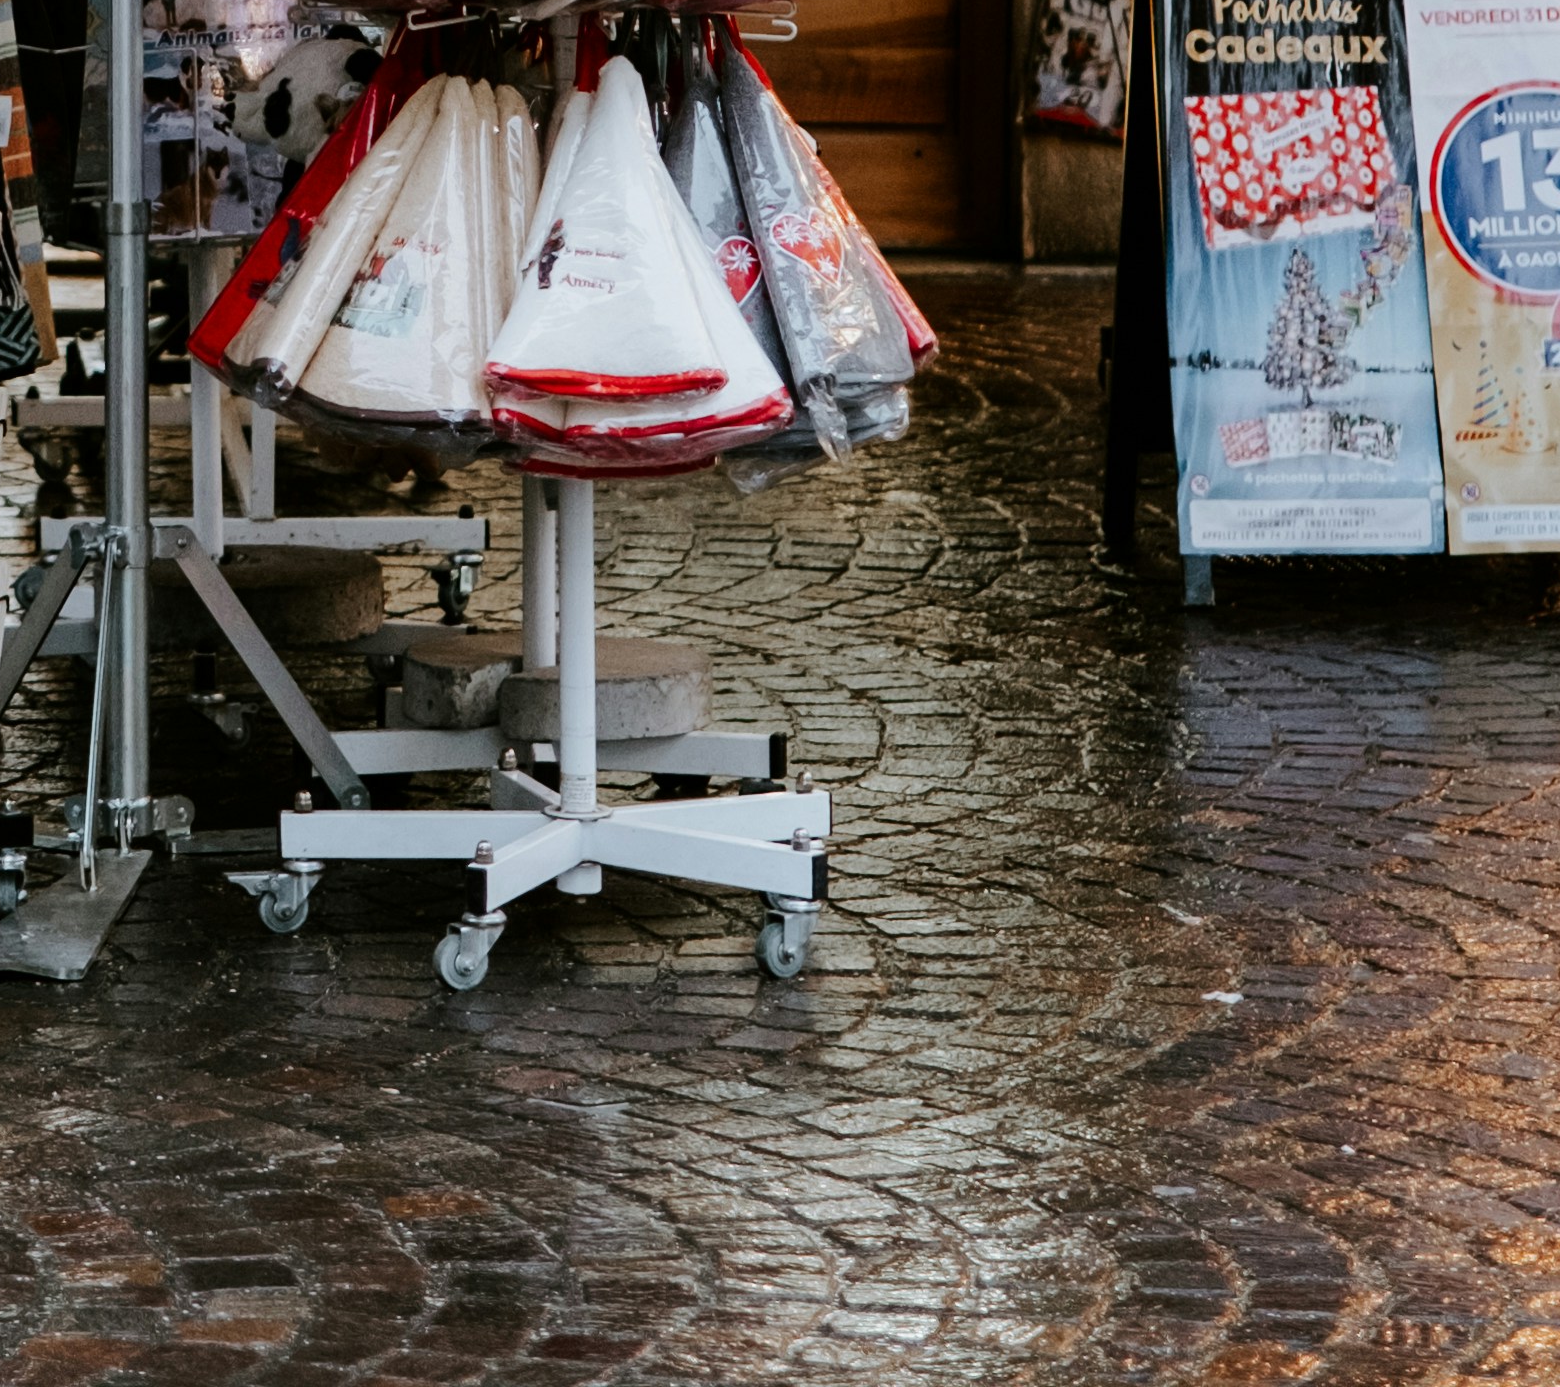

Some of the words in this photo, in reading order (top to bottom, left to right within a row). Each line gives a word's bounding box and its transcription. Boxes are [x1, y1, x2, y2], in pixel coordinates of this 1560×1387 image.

[1420, 8, 1520, 26] VENDREDI
[1523, 7, 1543, 23] 31
[1184, 28, 1389, 65] Cadeaux
[1497, 248, 1513, 270] À
